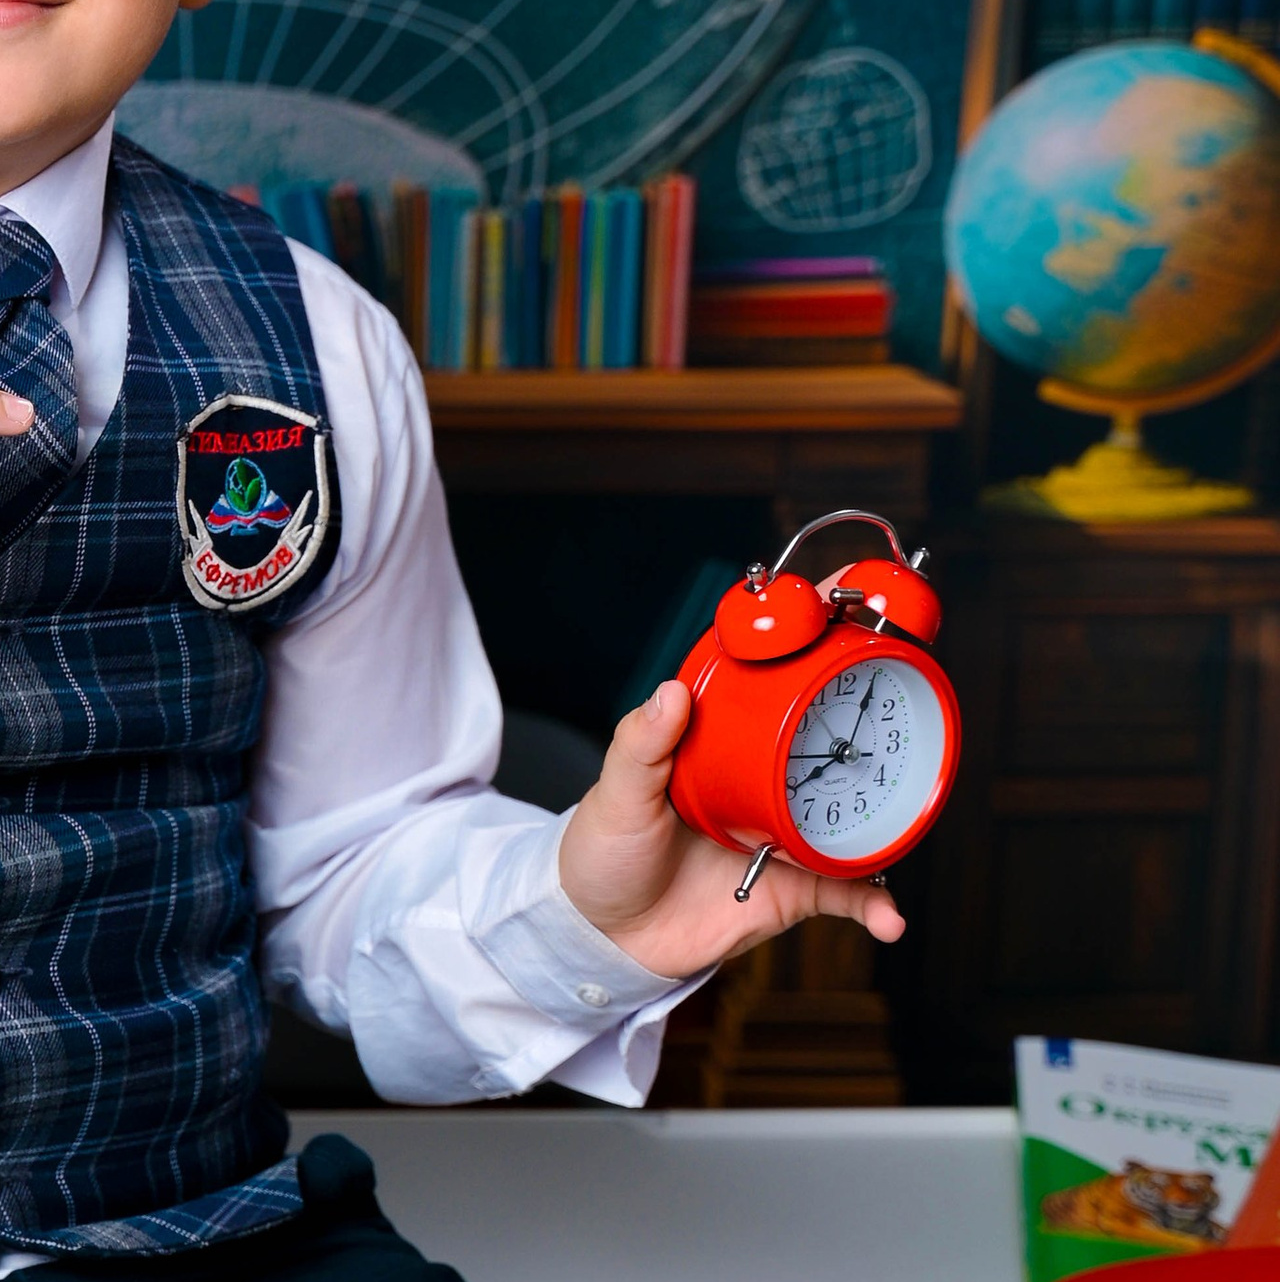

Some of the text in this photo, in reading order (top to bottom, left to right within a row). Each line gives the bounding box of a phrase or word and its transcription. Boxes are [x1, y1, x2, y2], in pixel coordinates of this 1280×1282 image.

[188, 424, 306, 454] ГИМНАЗИЯ
[196, 545, 294, 593] ЕФРЕМОВ
[833, 672, 857, 697] 12
[881, 698, 896, 722] 2
[886, 729, 901, 754] 3
[873, 763, 887, 787] 4
[786, 775, 798, 801] 8
[802, 797, 816, 822] 7
[826, 800, 841, 826] 6
[853, 790, 867, 814] 5
